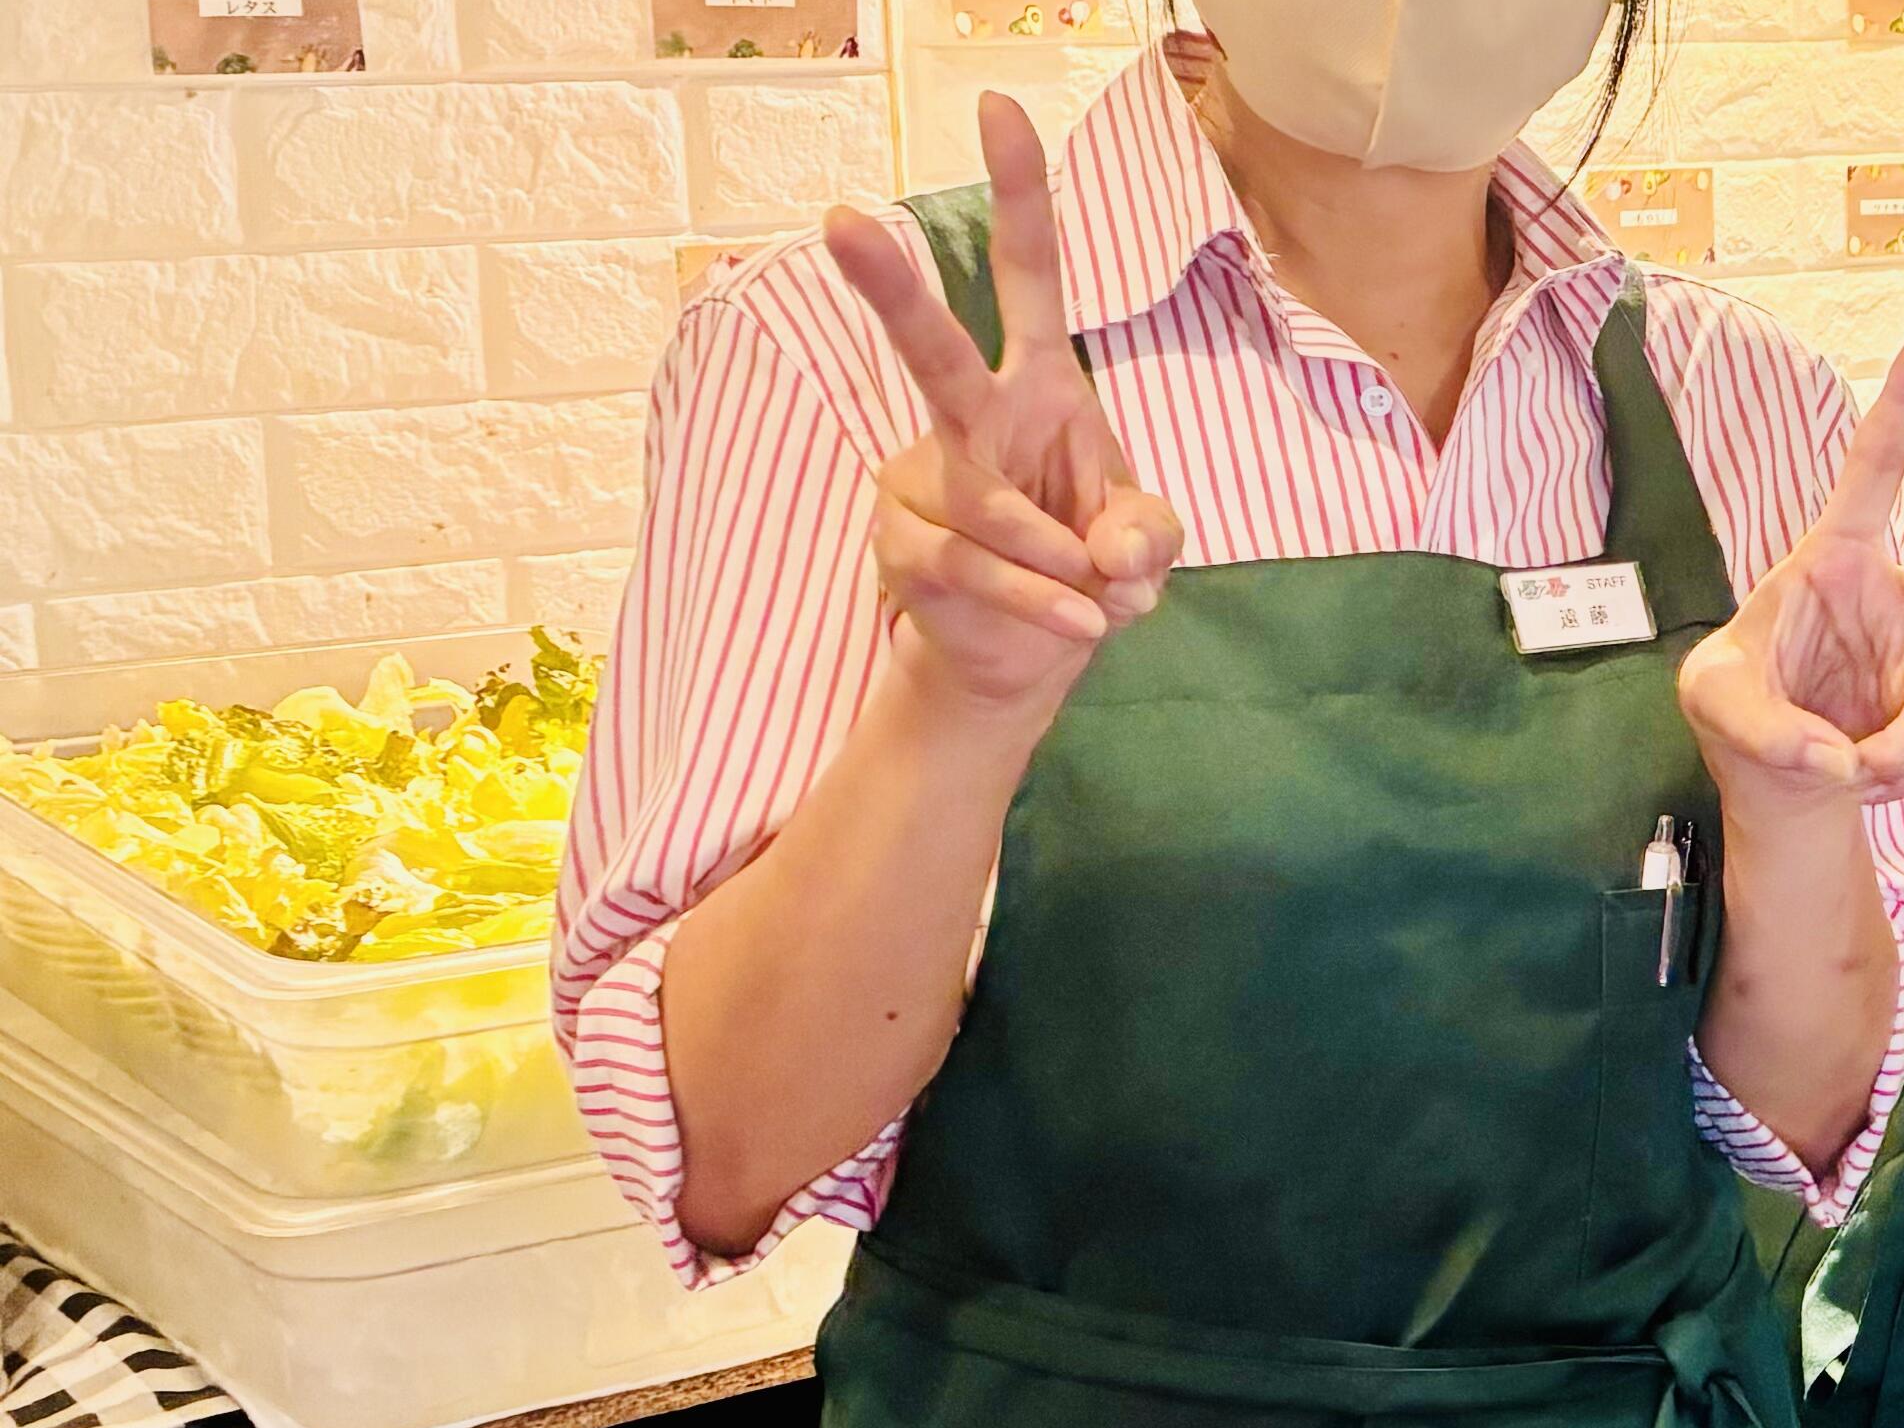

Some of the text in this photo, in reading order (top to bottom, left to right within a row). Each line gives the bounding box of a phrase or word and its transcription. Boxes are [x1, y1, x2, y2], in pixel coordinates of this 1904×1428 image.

[226, 0, 278, 15] レタス
[1586, 576, 1627, 590] STAFF
